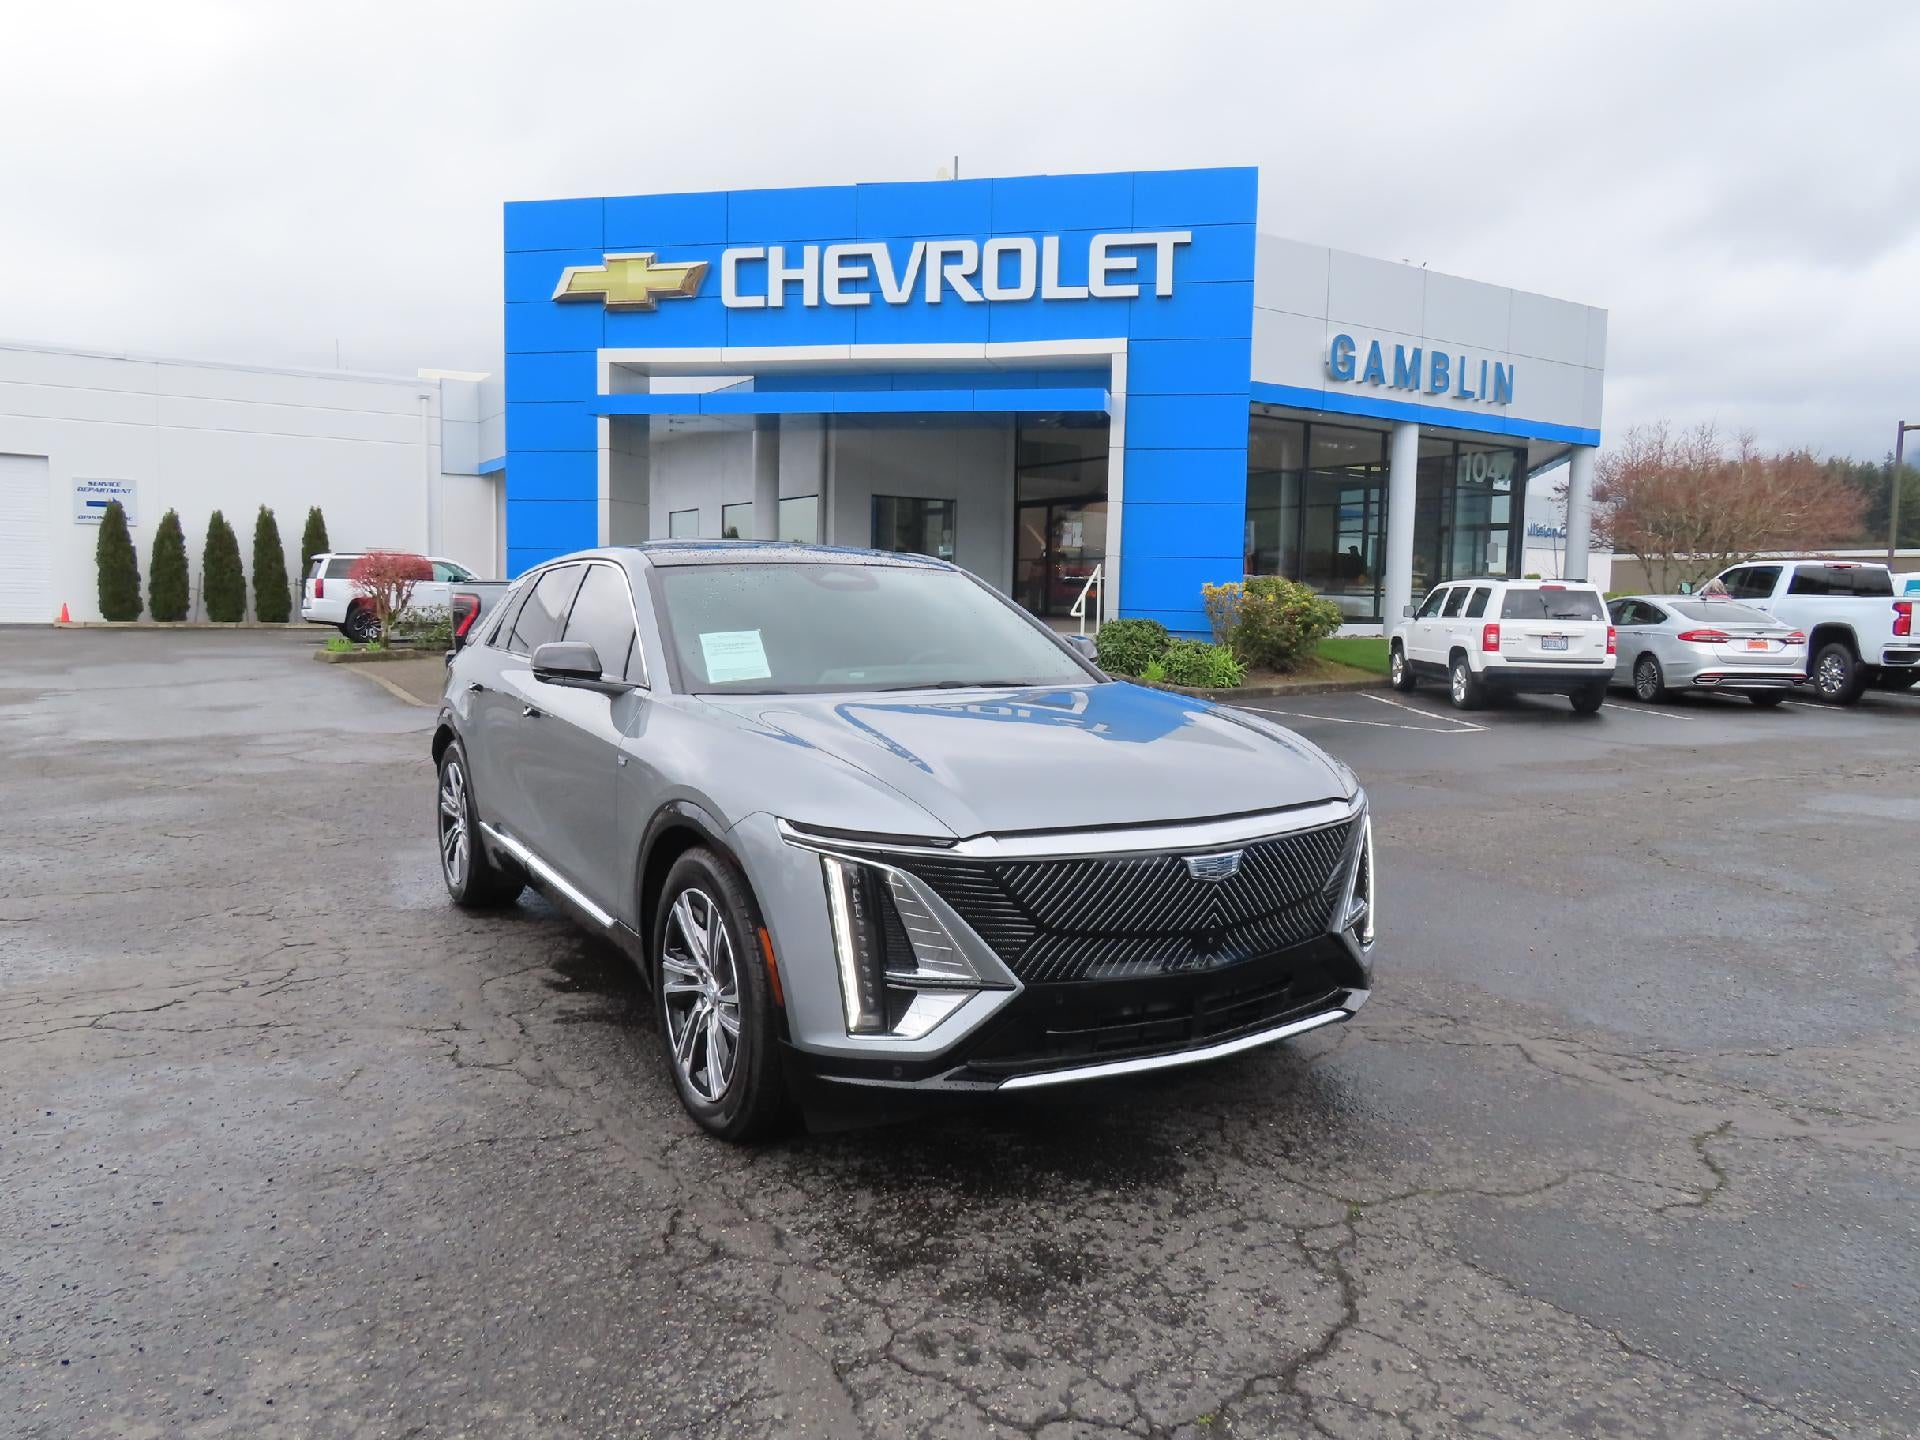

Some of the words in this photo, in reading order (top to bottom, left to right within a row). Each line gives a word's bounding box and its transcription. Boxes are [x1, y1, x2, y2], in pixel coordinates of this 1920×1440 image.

[721, 231, 1192, 309] CHEVROLET
[1328, 333, 1515, 405] GAMBLIN
[77, 486, 132, 494] DEPARTMENT
